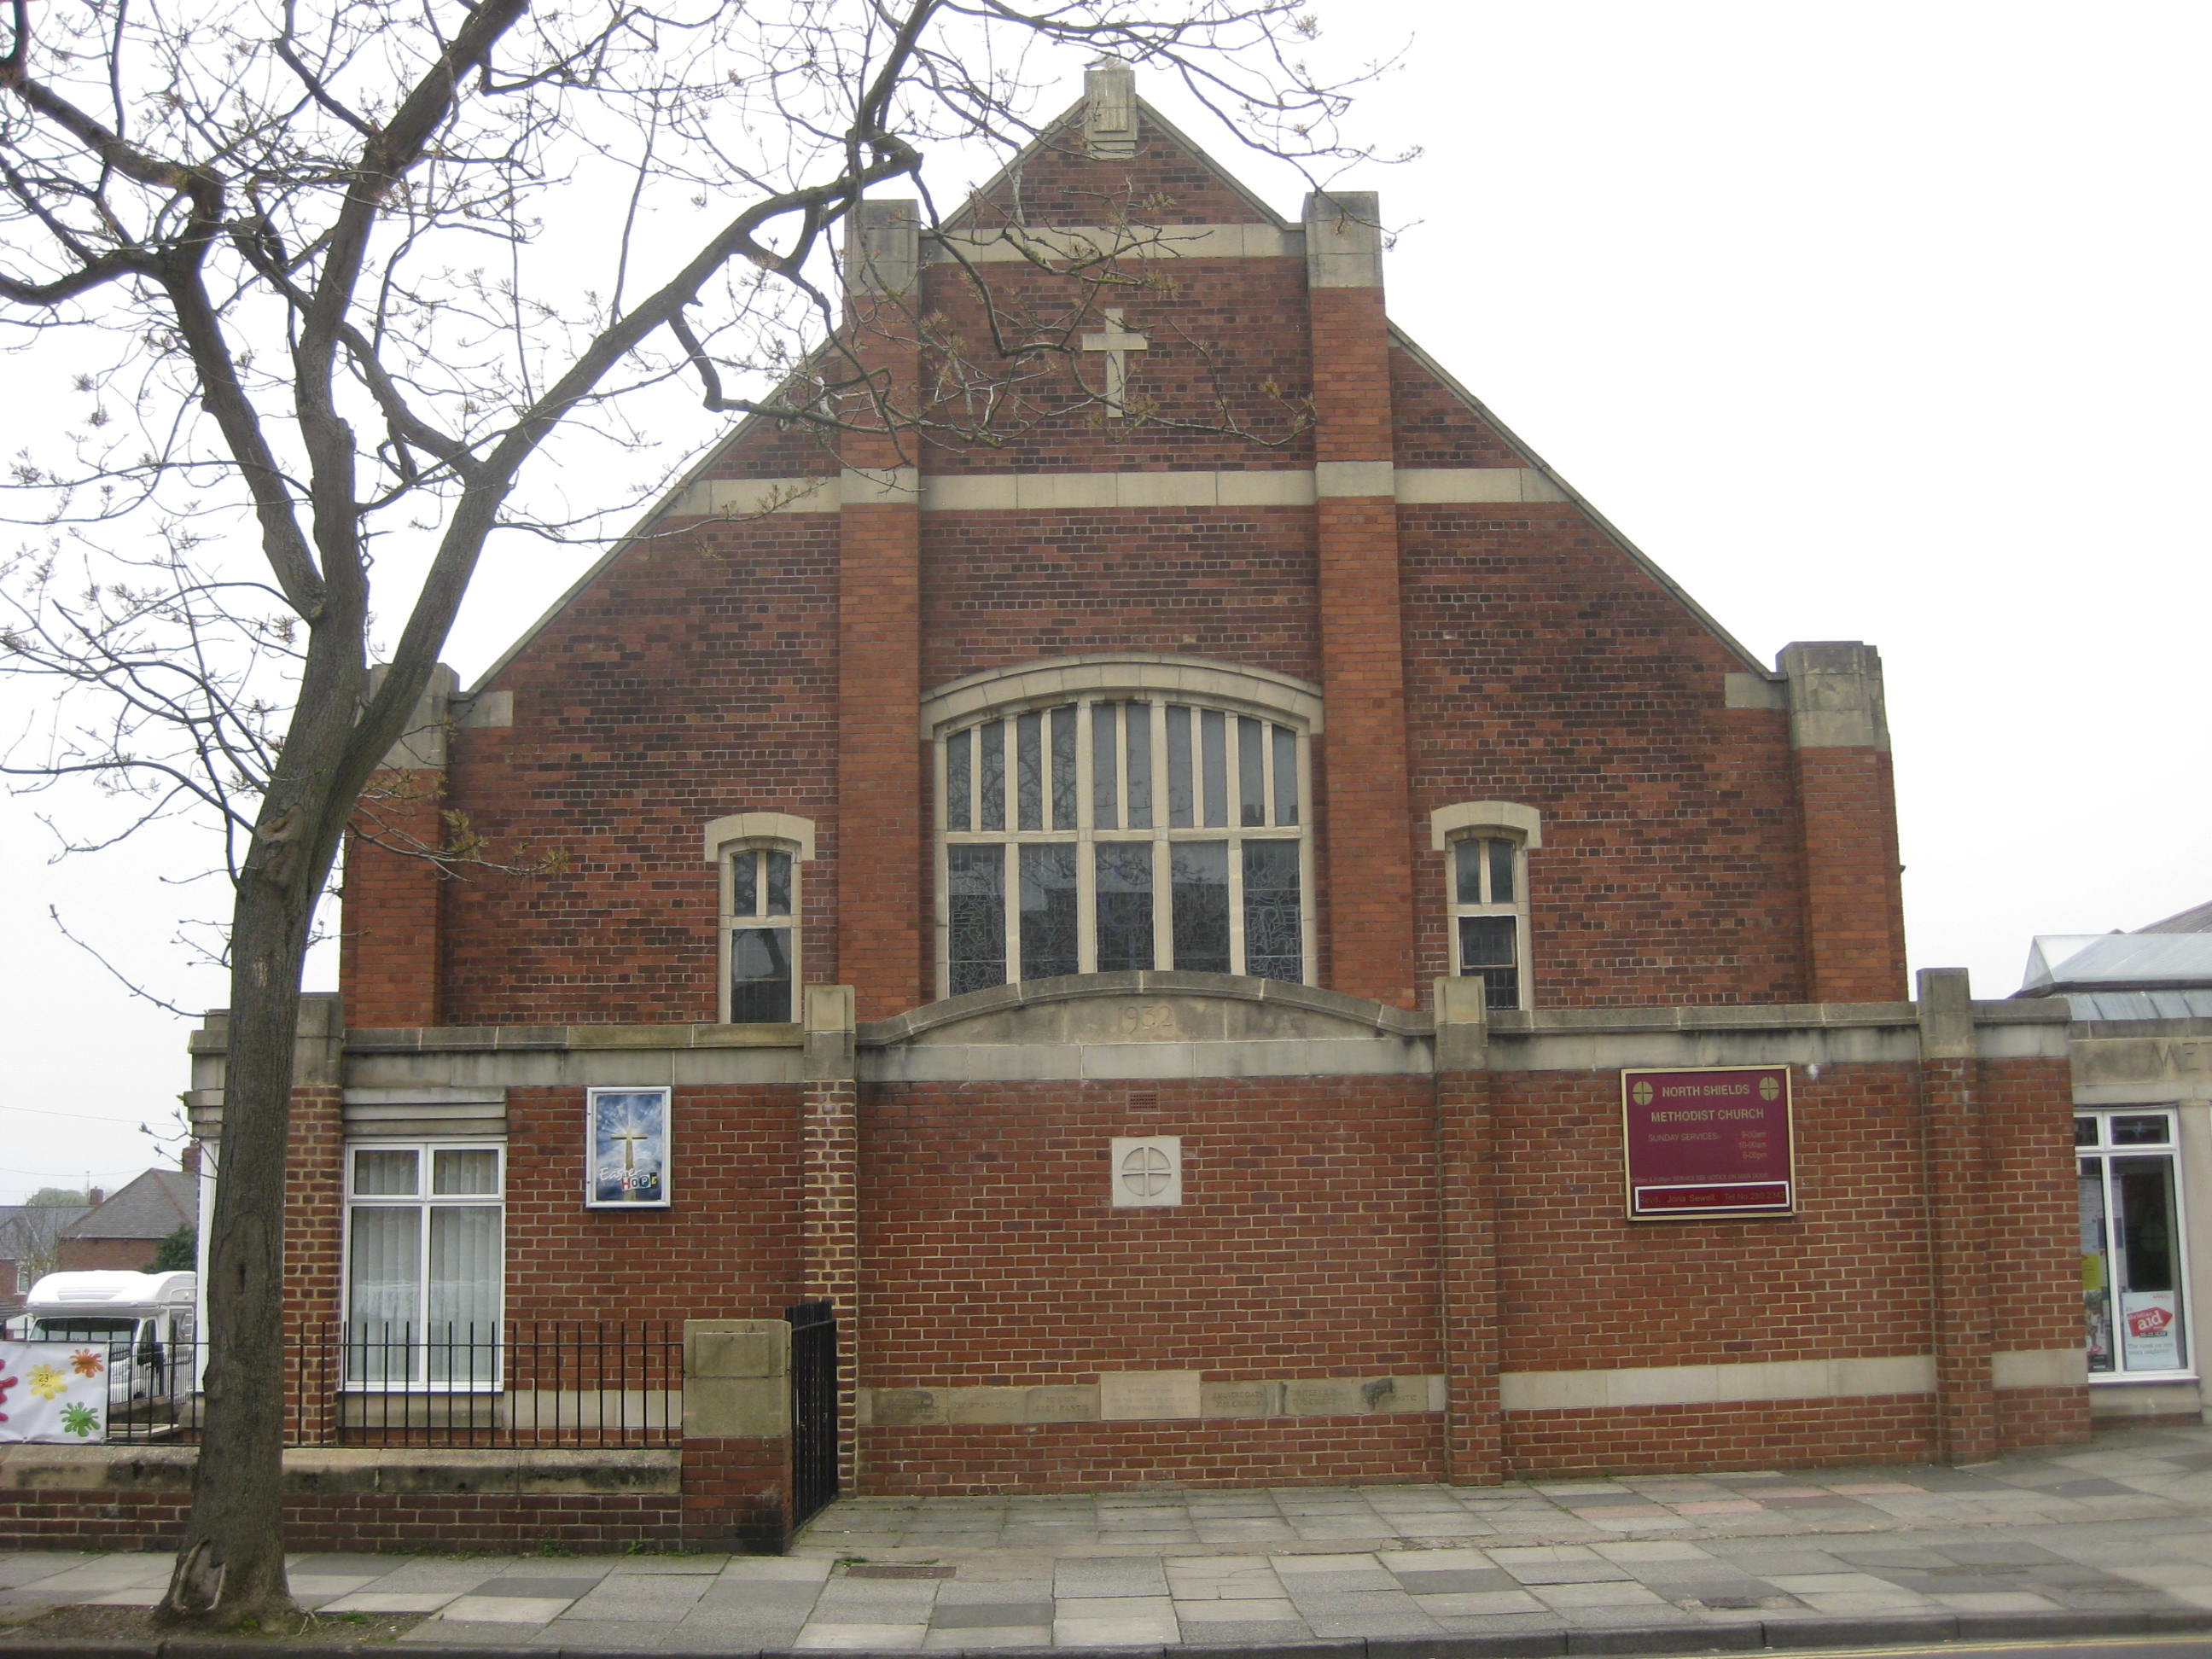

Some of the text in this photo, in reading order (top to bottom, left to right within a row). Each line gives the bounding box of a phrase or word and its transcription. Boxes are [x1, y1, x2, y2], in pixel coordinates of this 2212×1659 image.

[1119, 1004, 1173, 1034] 1932
[1662, 1084, 1750, 1097] NORTH SHIELDS
[1650, 1108, 1765, 1122] METHODIST CHURCH
[1648, 1132, 1679, 1142] SUNDAY
[599, 1167, 643, 1181] Easter
[621, 1175, 657, 1190] HOPE
[2136, 1309, 2163, 1330] aid
